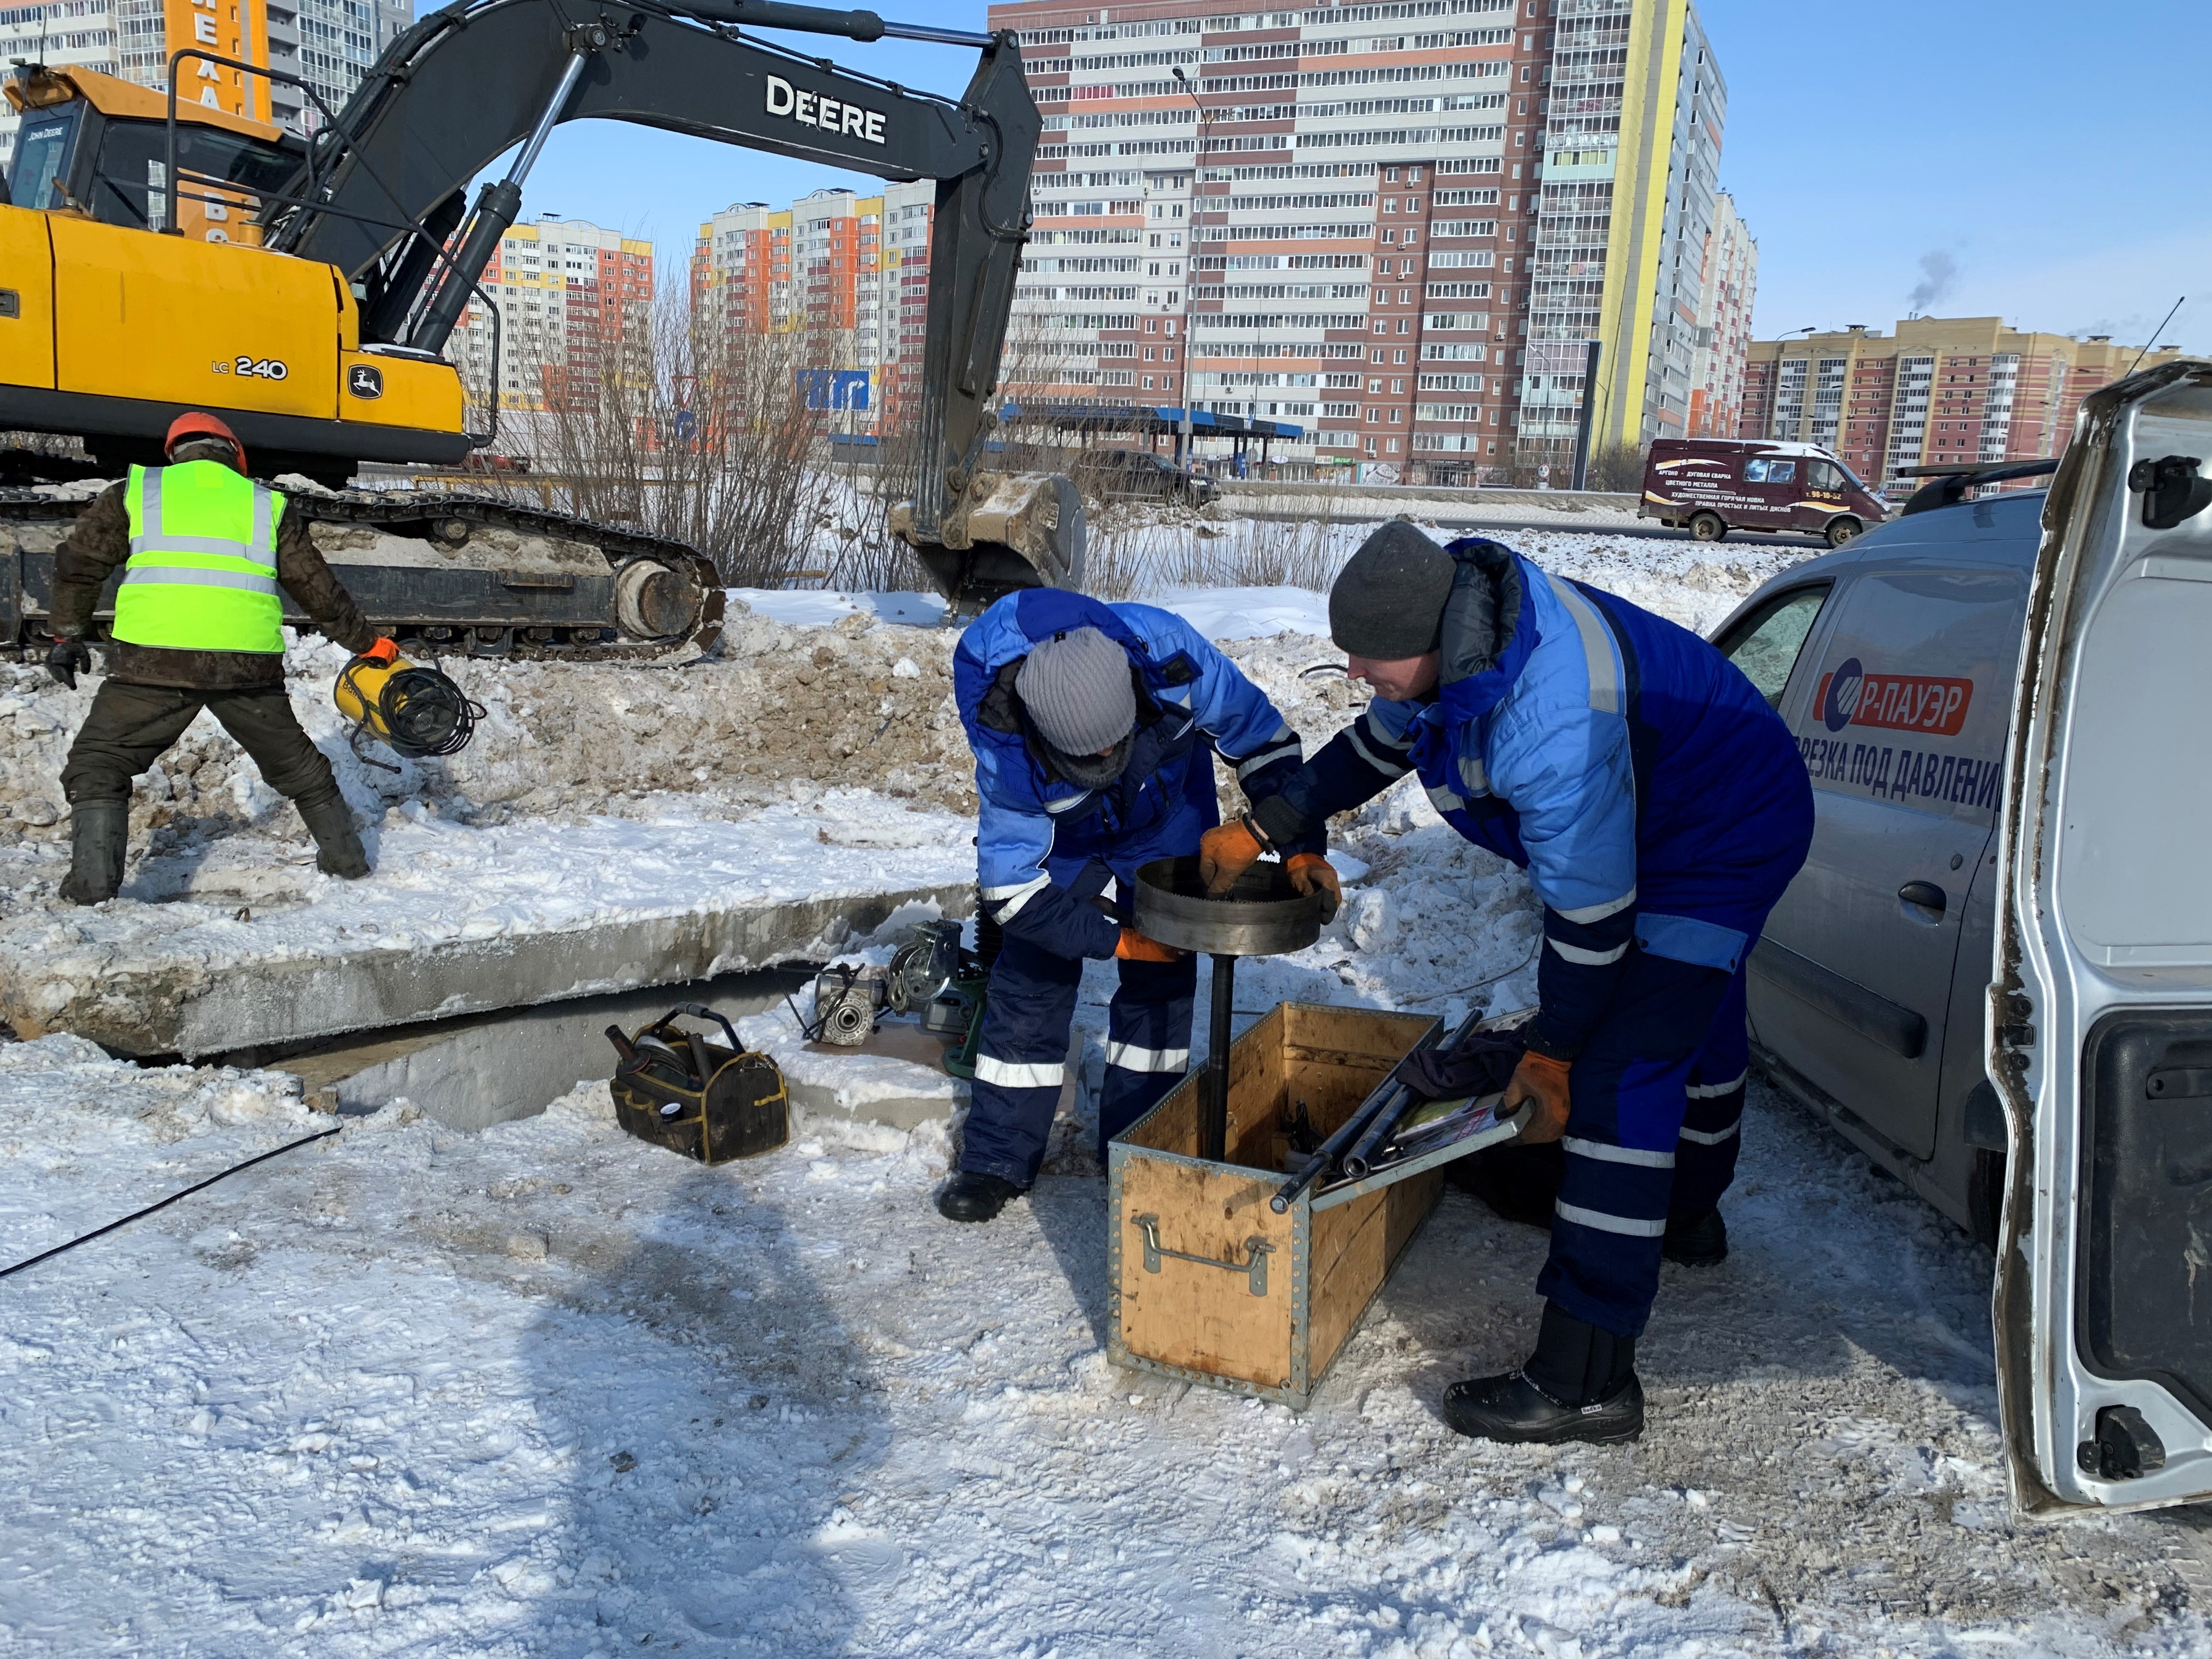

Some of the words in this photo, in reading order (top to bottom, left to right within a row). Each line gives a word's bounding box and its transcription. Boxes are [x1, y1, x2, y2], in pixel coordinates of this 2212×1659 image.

[766, 74, 887, 144] DEERE
[28, 131, 44, 142] JOHN
[43, 127, 63, 138] DEERE
[212, 360, 229, 374] LC
[234, 356, 289, 381] 240
[1671, 492, 1720, 500] ХУДОЖЕСТВЕННАЯ
[1849, 744, 1893, 798] ПОД
[1891, 749, 2002, 812] ДАВЛЕНИ
